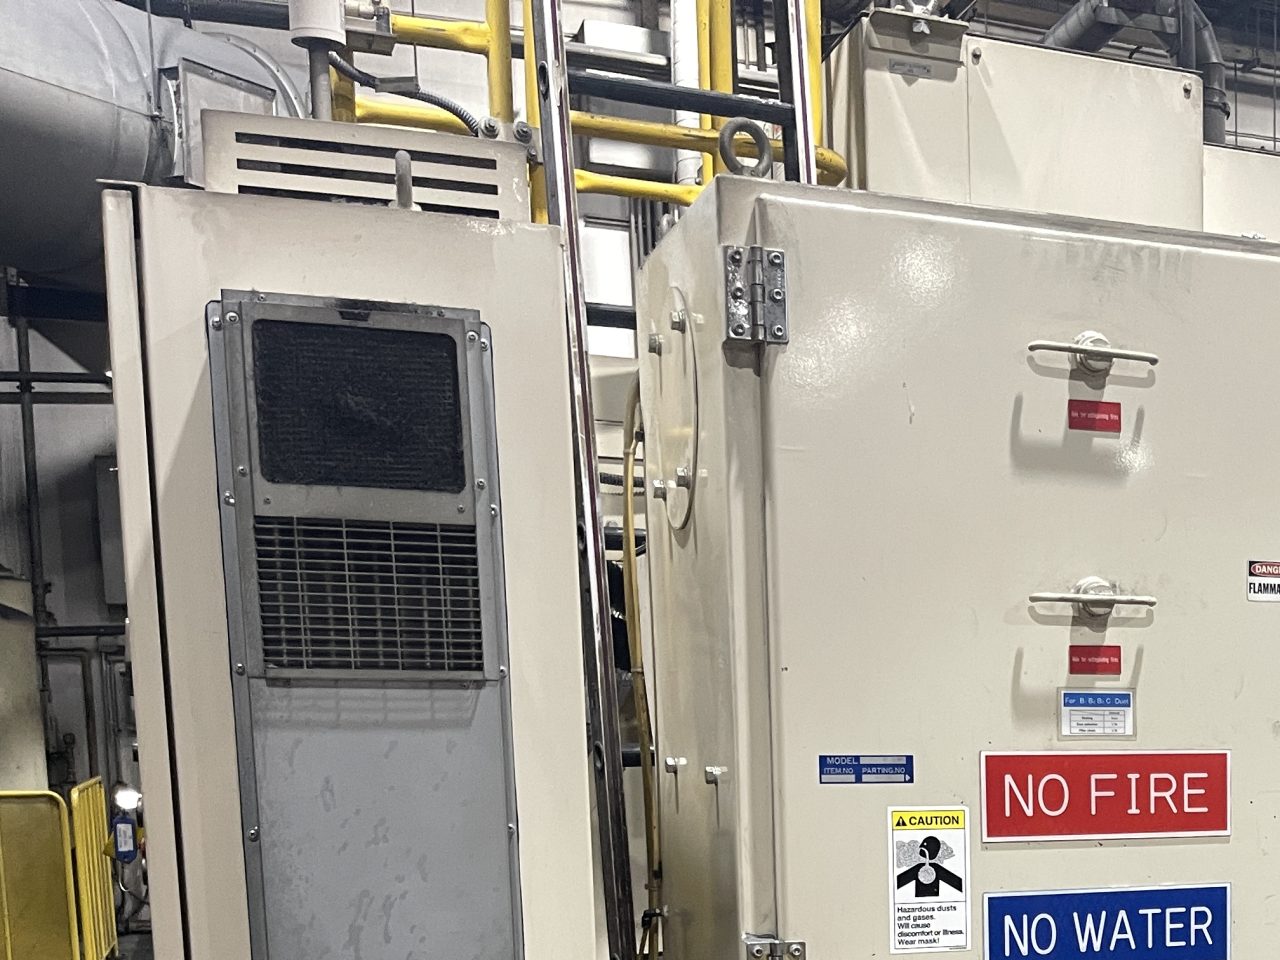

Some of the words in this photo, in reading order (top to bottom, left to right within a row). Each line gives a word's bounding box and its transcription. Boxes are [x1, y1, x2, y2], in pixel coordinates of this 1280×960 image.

[826, 757, 858, 765] MODEL
[1004, 774, 1069, 817] NO
[1090, 773, 1208, 815] FIRE
[909, 816, 959, 826] CAUTION
[912, 914, 936, 922] gases.
[1004, 913, 1057, 957] NO
[1073, 906, 1213, 952] WATER
